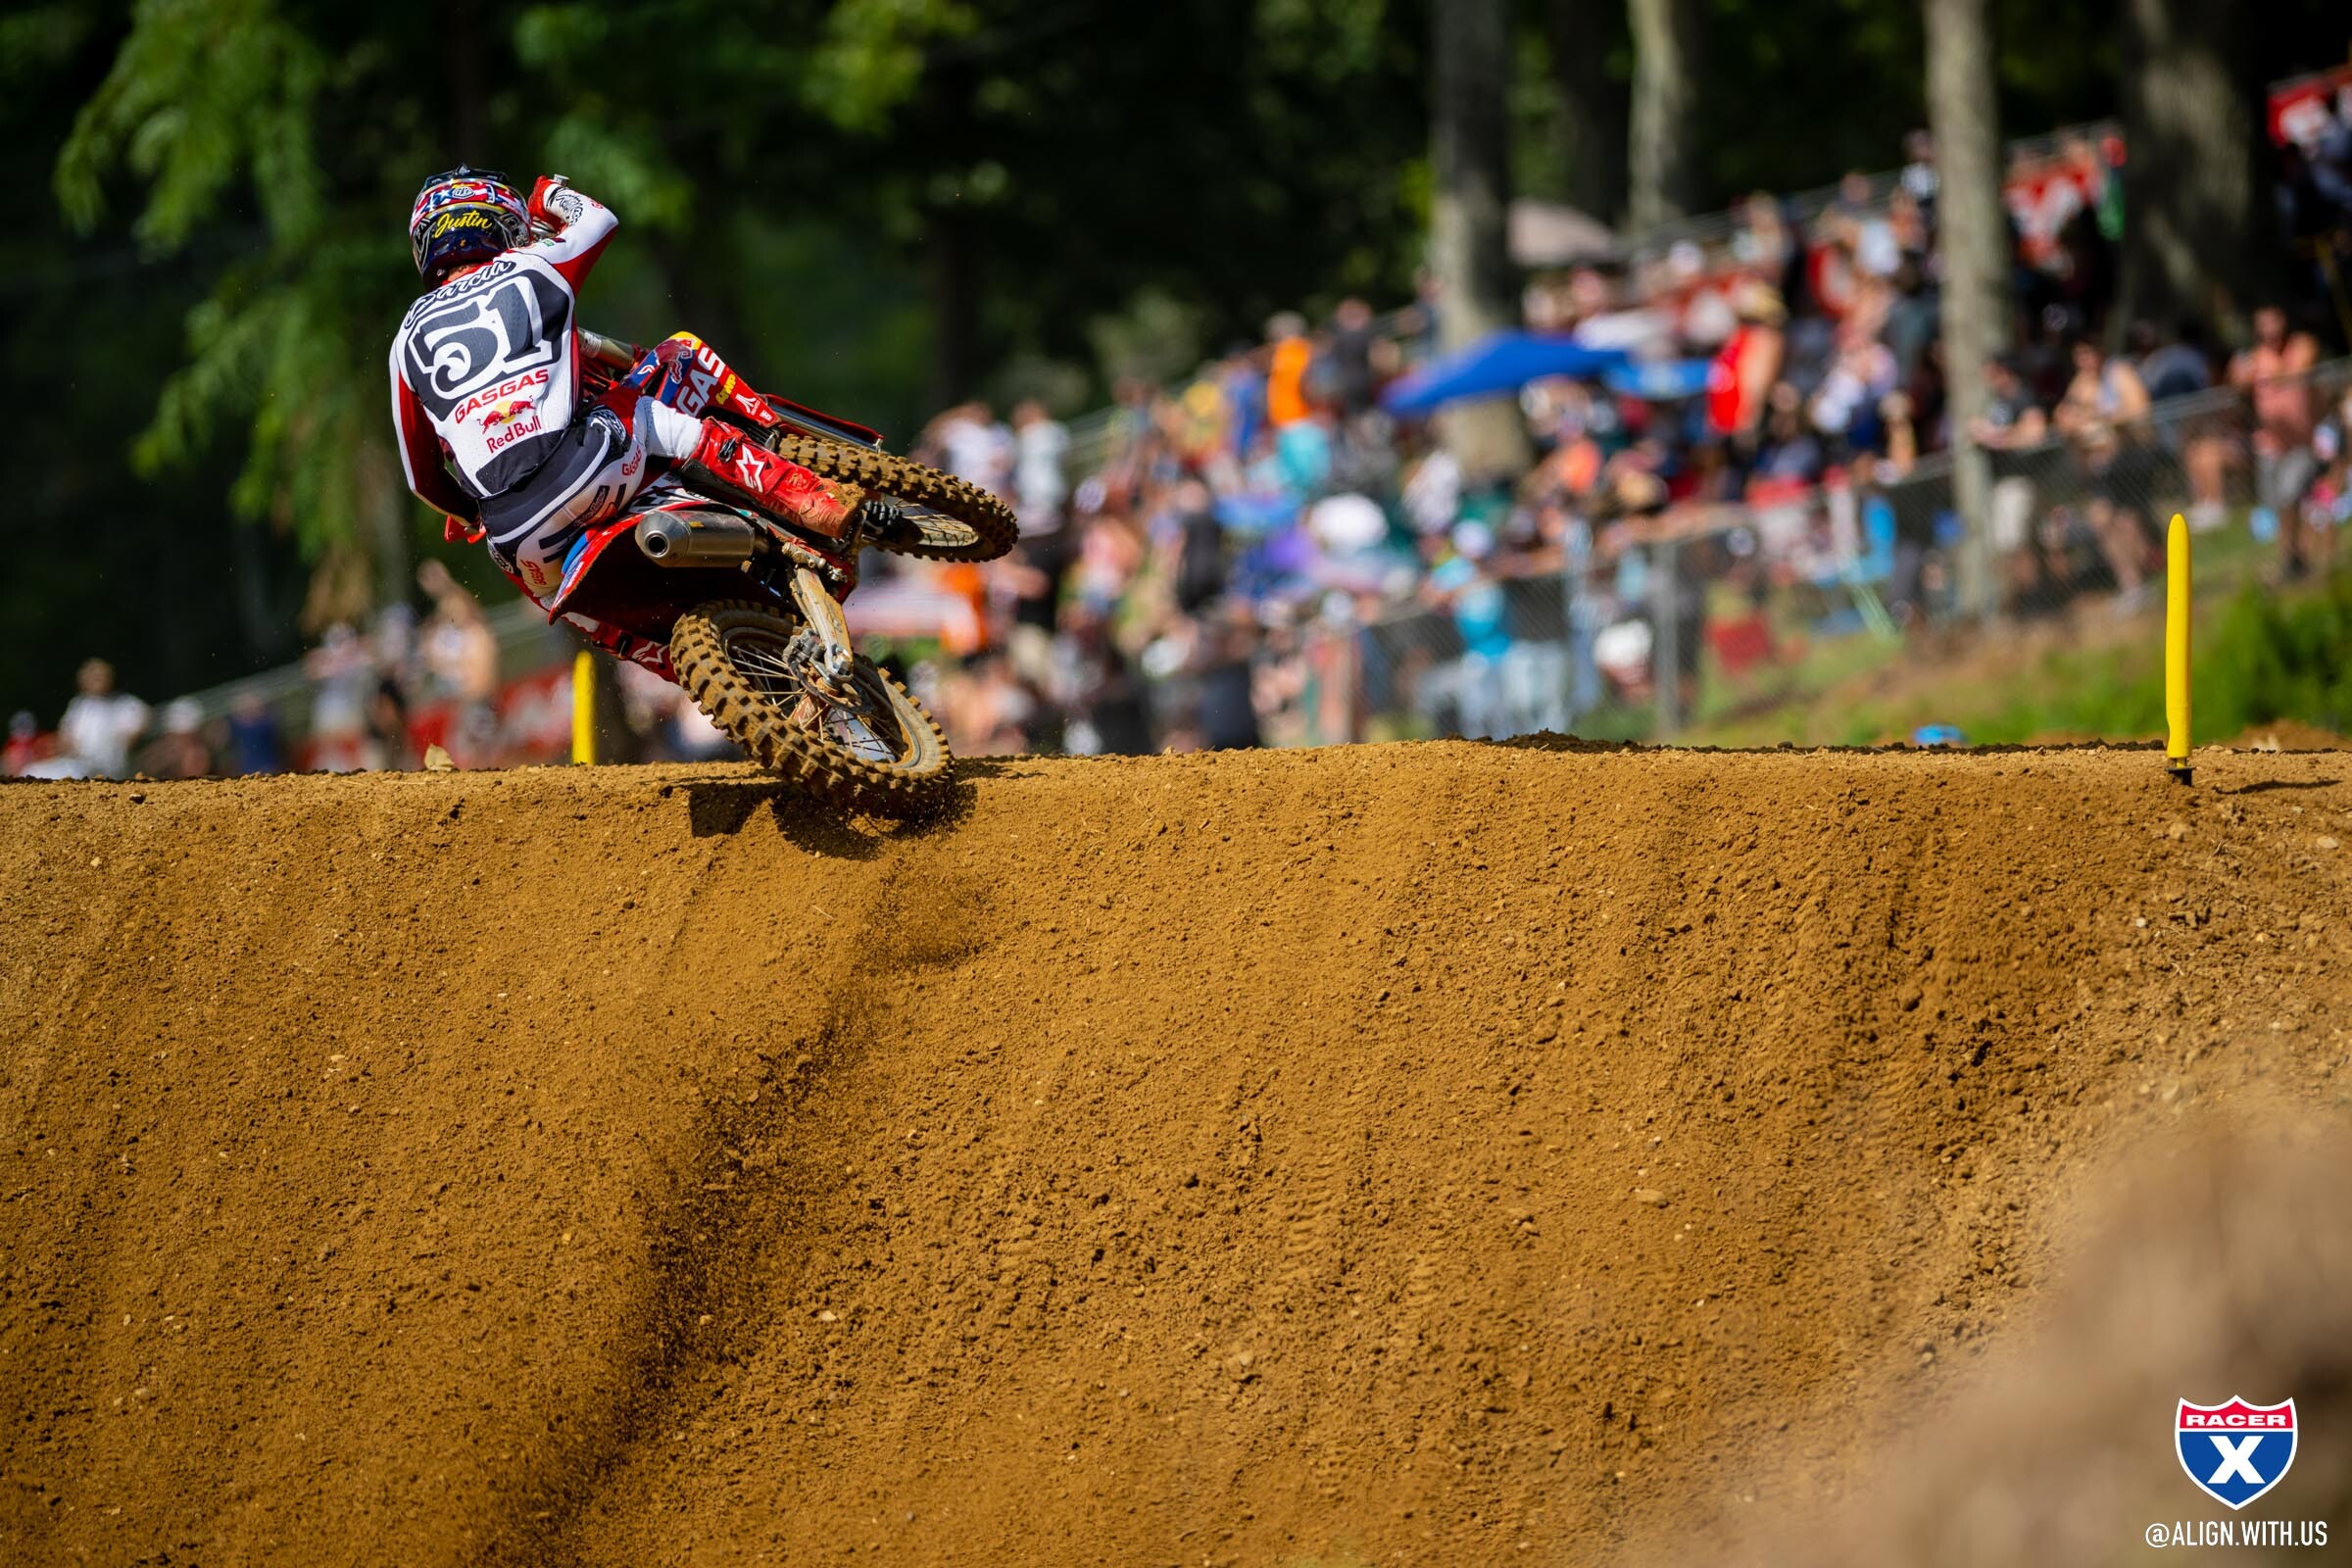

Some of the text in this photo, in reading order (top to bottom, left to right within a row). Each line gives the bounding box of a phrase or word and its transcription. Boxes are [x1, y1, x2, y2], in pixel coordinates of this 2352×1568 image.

[433, 210, 492, 238] Justin
[412, 280, 545, 394] 51
[455, 368, 549, 424] GASGAS
[676, 346, 726, 418] GAS
[486, 416, 542, 454] Red Bull
